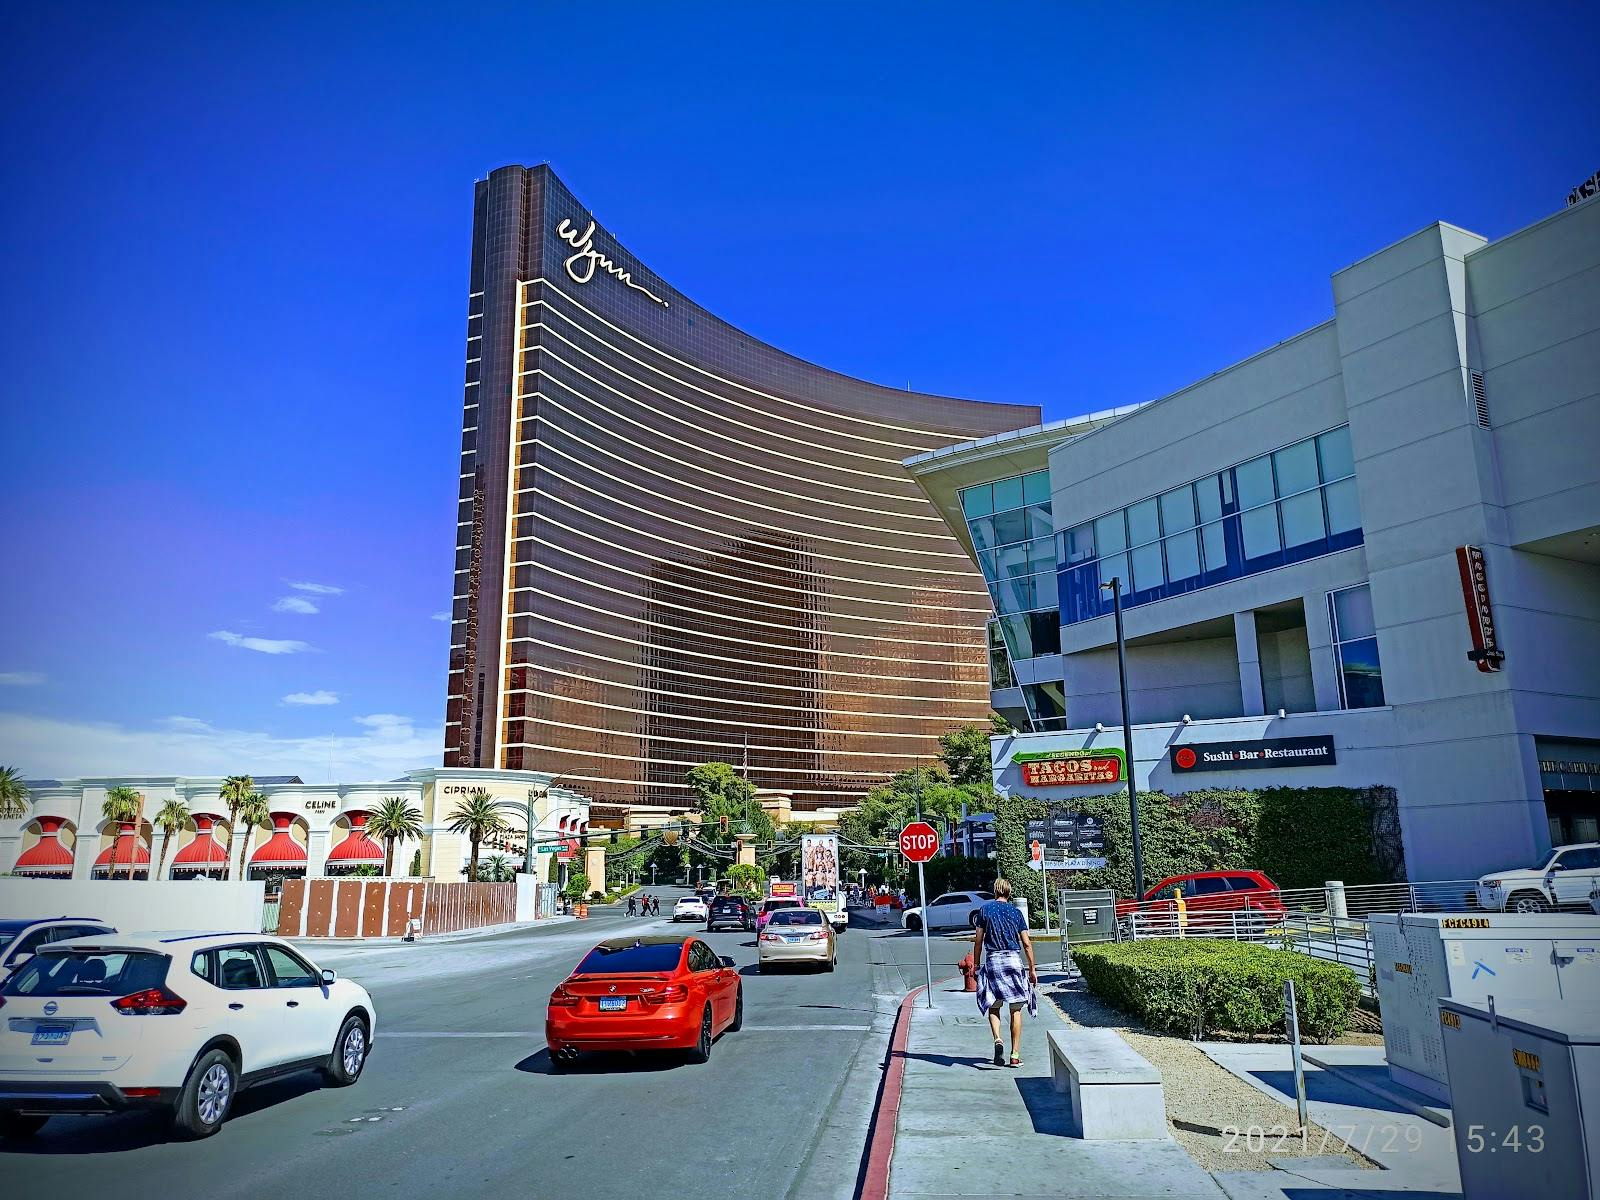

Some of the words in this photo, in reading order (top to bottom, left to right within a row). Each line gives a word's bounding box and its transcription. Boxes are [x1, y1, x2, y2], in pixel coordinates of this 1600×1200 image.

[1203, 751, 1235, 762] Sushi
[1239, 750, 1259, 760] Bar
[1263, 745, 1329, 759] Restaurant
[1027, 759, 1093, 775] TACOS
[1029, 771, 1114, 784] MARGARITAS
[443, 786, 486, 795] CIPRIANI
[305, 801, 337, 809] CELINE
[902, 834, 936, 850] STOP
